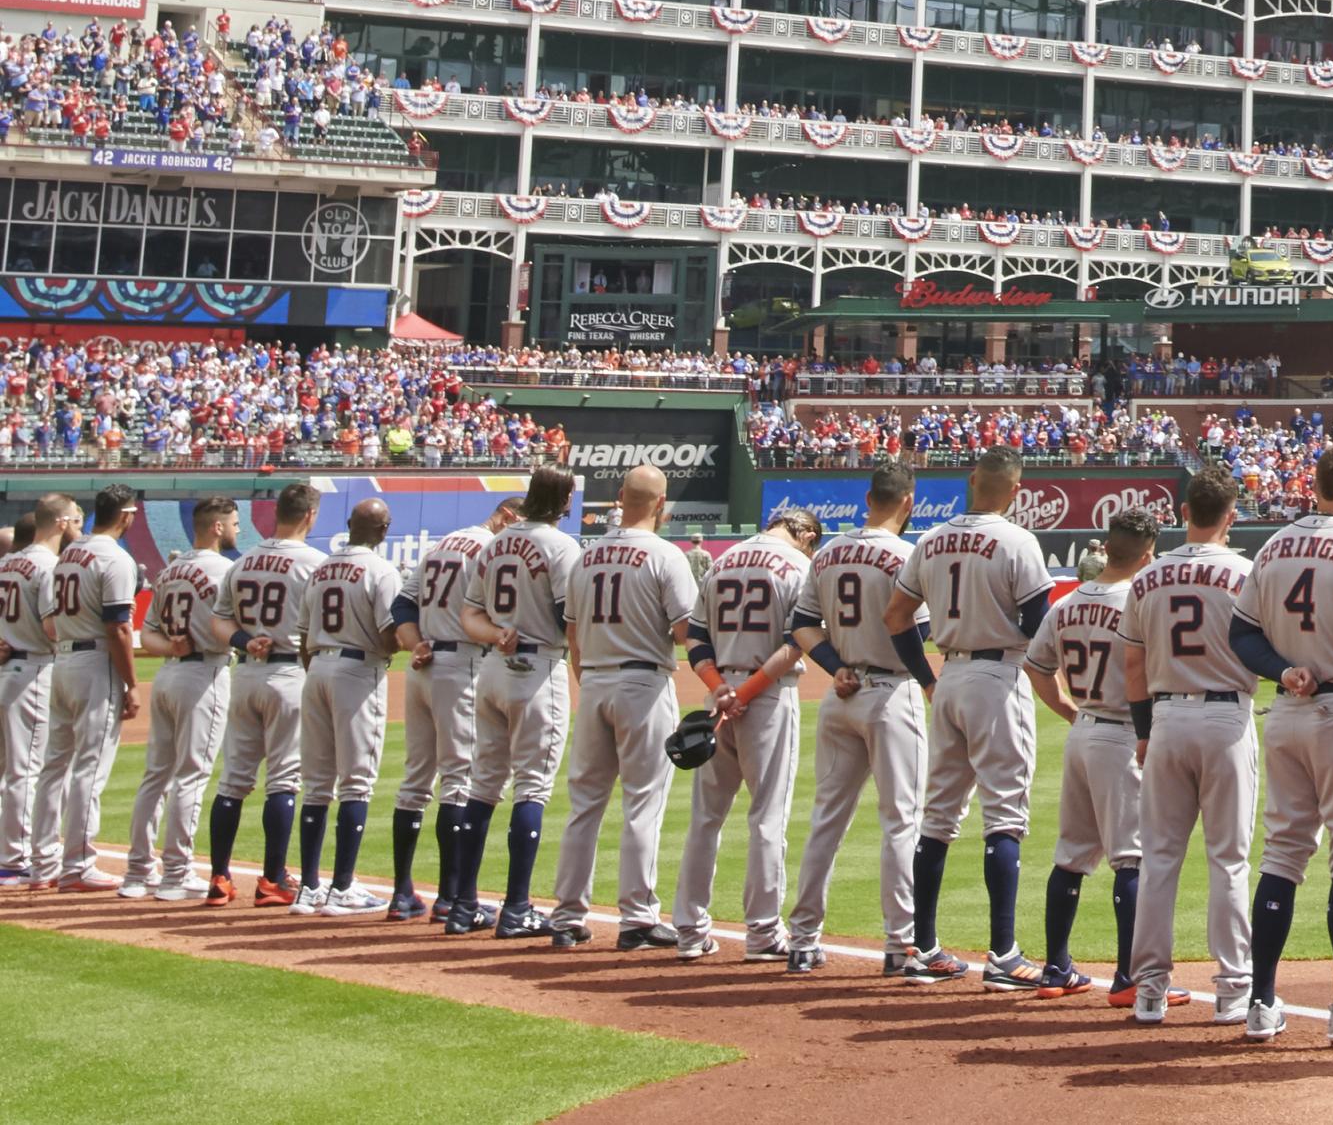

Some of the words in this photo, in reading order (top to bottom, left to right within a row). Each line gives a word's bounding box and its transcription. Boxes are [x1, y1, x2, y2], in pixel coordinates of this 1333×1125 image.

[94, 151, 114, 165] 42
[121, 155, 156, 167] JACKIE
[162, 155, 208, 168] ROBINSON
[213, 157, 233, 172] 42
[22, 182, 99, 222] JACK
[325, 208, 351, 220] OLD
[320, 256, 348, 268] CLUB
[1191, 288, 1300, 305] HYUNDAI
[568, 331, 586, 340] FINE
[589, 331, 614, 340] TEXAS
[629, 332, 665, 341] WHISKEY
[570, 312, 627, 330] REBECCA
[630, 311, 675, 329] CREEK
[242, 555, 295, 574] DAVIS
[583, 546, 649, 569] GATTIS
[713, 549, 797, 581] REDDICK
[814, 544, 905, 577] GONZALEZ
[924, 532, 999, 561] CORREA
[53, 573, 80, 616] 30
[237, 579, 287, 628] 28
[420, 560, 464, 609] 37
[493, 564, 518, 614] 6
[592, 572, 623, 624] 11
[837, 572, 862, 627] 9
[948, 561, 963, 620] 1
[1284, 567, 1316, 632] 4
[160, 591, 194, 636] 43
[322, 586, 346, 634] 8
[717, 579, 773, 633] 22
[1056, 603, 1122, 633] ALTUVE
[1170, 595, 1206, 657] 2
[1061, 638, 1112, 701] 27
